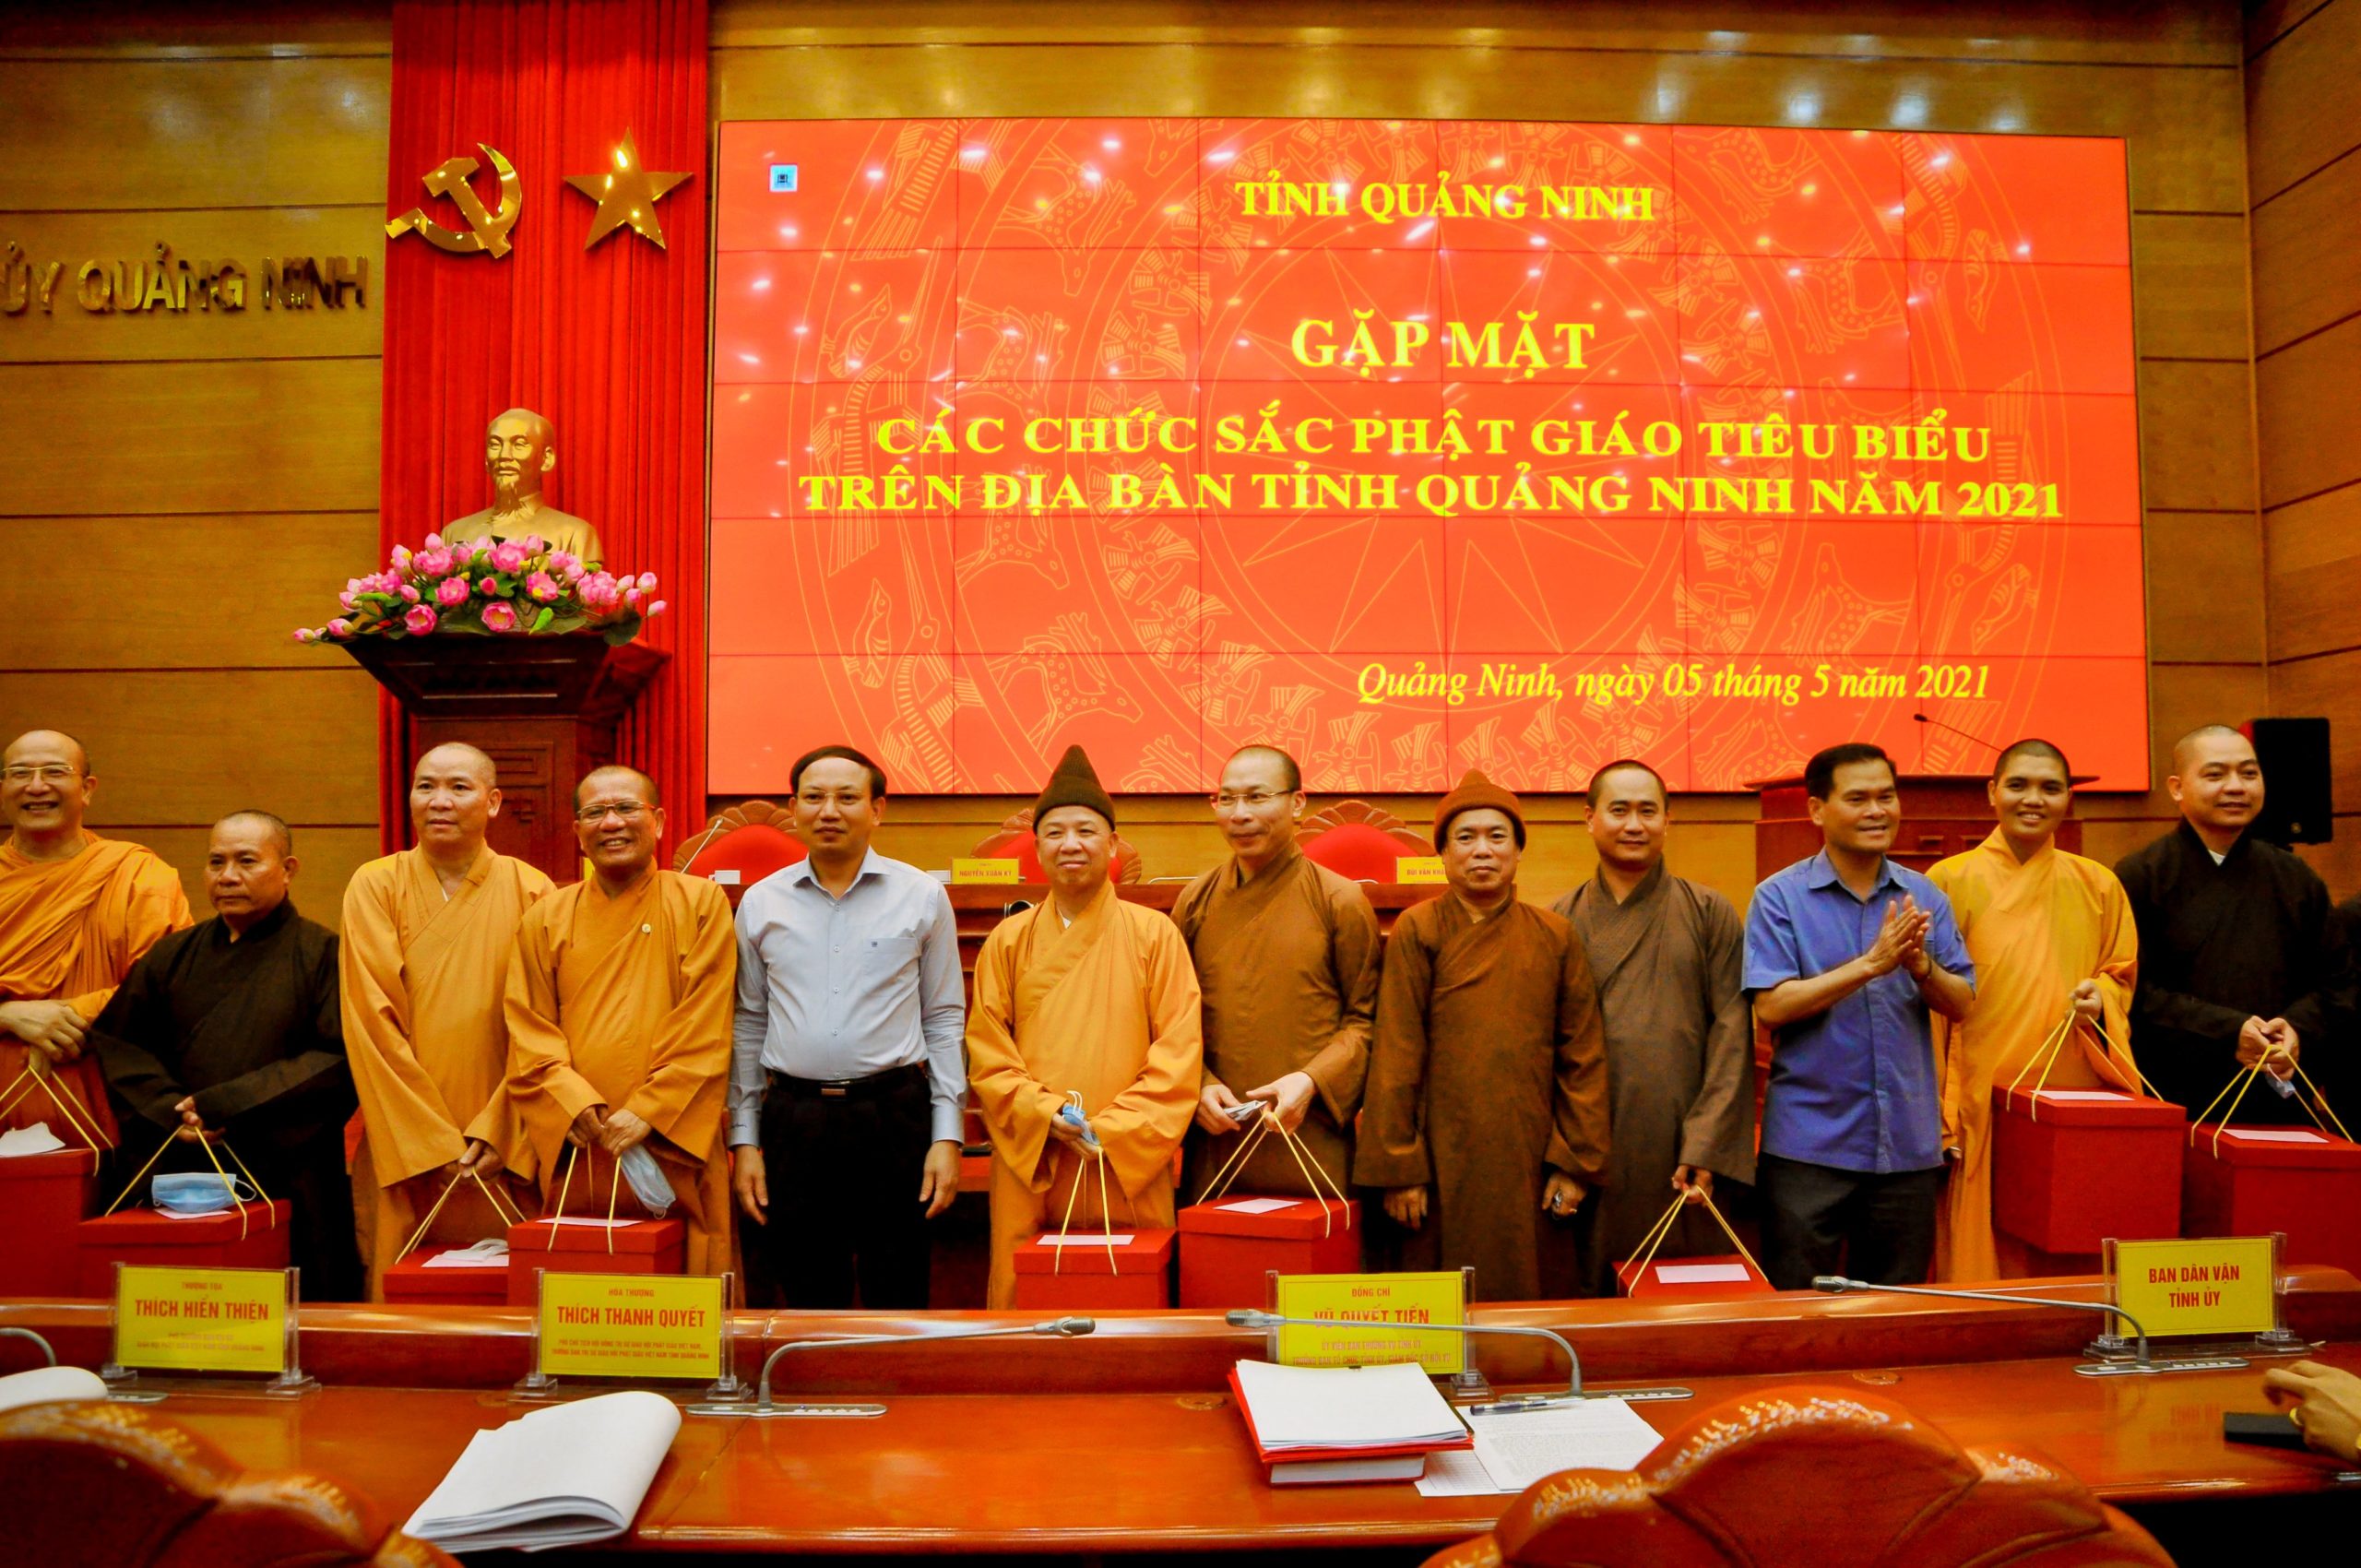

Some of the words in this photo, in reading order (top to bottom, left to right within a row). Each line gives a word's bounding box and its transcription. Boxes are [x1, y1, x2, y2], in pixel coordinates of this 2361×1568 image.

[1234, 168, 1349, 217] TỈNH
[1360, 171, 1528, 224] QUẢNG
[1539, 184, 1655, 221] NINH
[77, 241, 247, 314] QUẢNG
[260, 256, 369, 311] NINH
[1291, 308, 1430, 378] GẶP
[1446, 310, 1595, 379] MẶT
[876, 406, 1004, 455] CÁC
[1024, 406, 1196, 454] CHỨC
[1216, 398, 1333, 454] SẮC
[1351, 408, 1514, 462] PHẬT
[1531, 410, 1682, 457] GIÁO
[1698, 412, 1837, 459] TIÊU
[1853, 408, 1990, 462] BIỂU
[799, 464, 965, 511] TRÊN
[980, 473, 1089, 517] ĐỊA
[1106, 462, 1235, 509] BÀN
[1252, 460, 1400, 509] TỈNH
[1416, 461, 1631, 517] QUẢNG
[1648, 477, 1795, 513] NINH
[1809, 471, 1942, 516] NĂM
[1957, 481, 2062, 518] 2021
[1358, 661, 1468, 706] Quảng
[1476, 662, 1563, 701] Ninh,
[1575, 663, 1655, 706] ngày
[1662, 662, 1703, 697] 05
[1713, 663, 1802, 706] tháng
[1810, 663, 1831, 697] 5
[1839, 666, 1906, 698] năm
[1916, 665, 1989, 698] 2021
[2148, 1268, 2177, 1284] BAN
[2180, 1264, 2209, 1283] DÂN
[2213, 1262, 2239, 1284] VẬN
[2169, 1287, 2200, 1308] TỈNH
[2203, 1286, 2220, 1307] ỦY
[135, 1296, 178, 1318] THÍCH
[224, 1299, 269, 1324] THIỆN
[556, 1301, 600, 1325] THÍCH
[604, 1308, 654, 1326] THANH
[658, 1304, 706, 1328] QUYẾT
